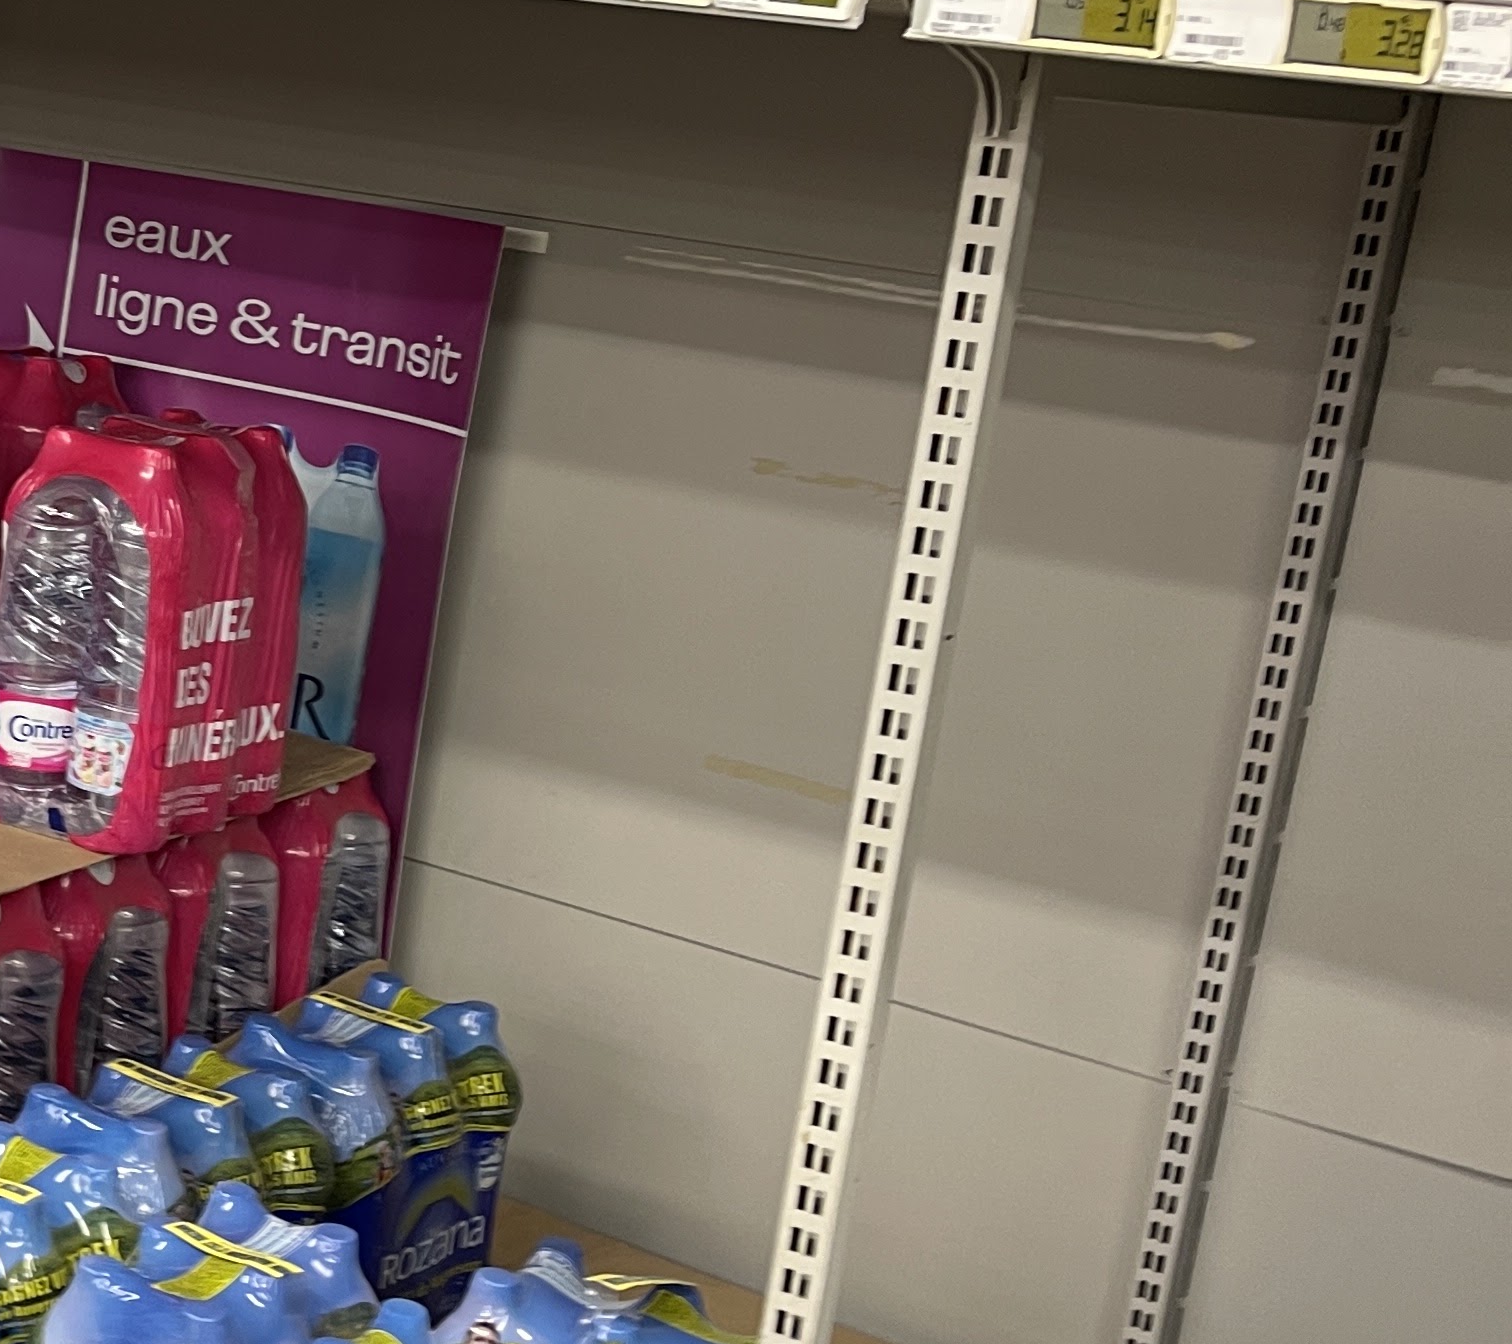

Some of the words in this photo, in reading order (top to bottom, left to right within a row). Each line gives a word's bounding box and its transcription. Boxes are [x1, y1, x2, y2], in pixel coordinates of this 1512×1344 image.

[104, 214, 233, 266] eaux
[93, 273, 218, 336] ligne
[230, 298, 281, 349] &
[292, 312, 463, 385] transit
[8, 715, 74, 743] Contre
